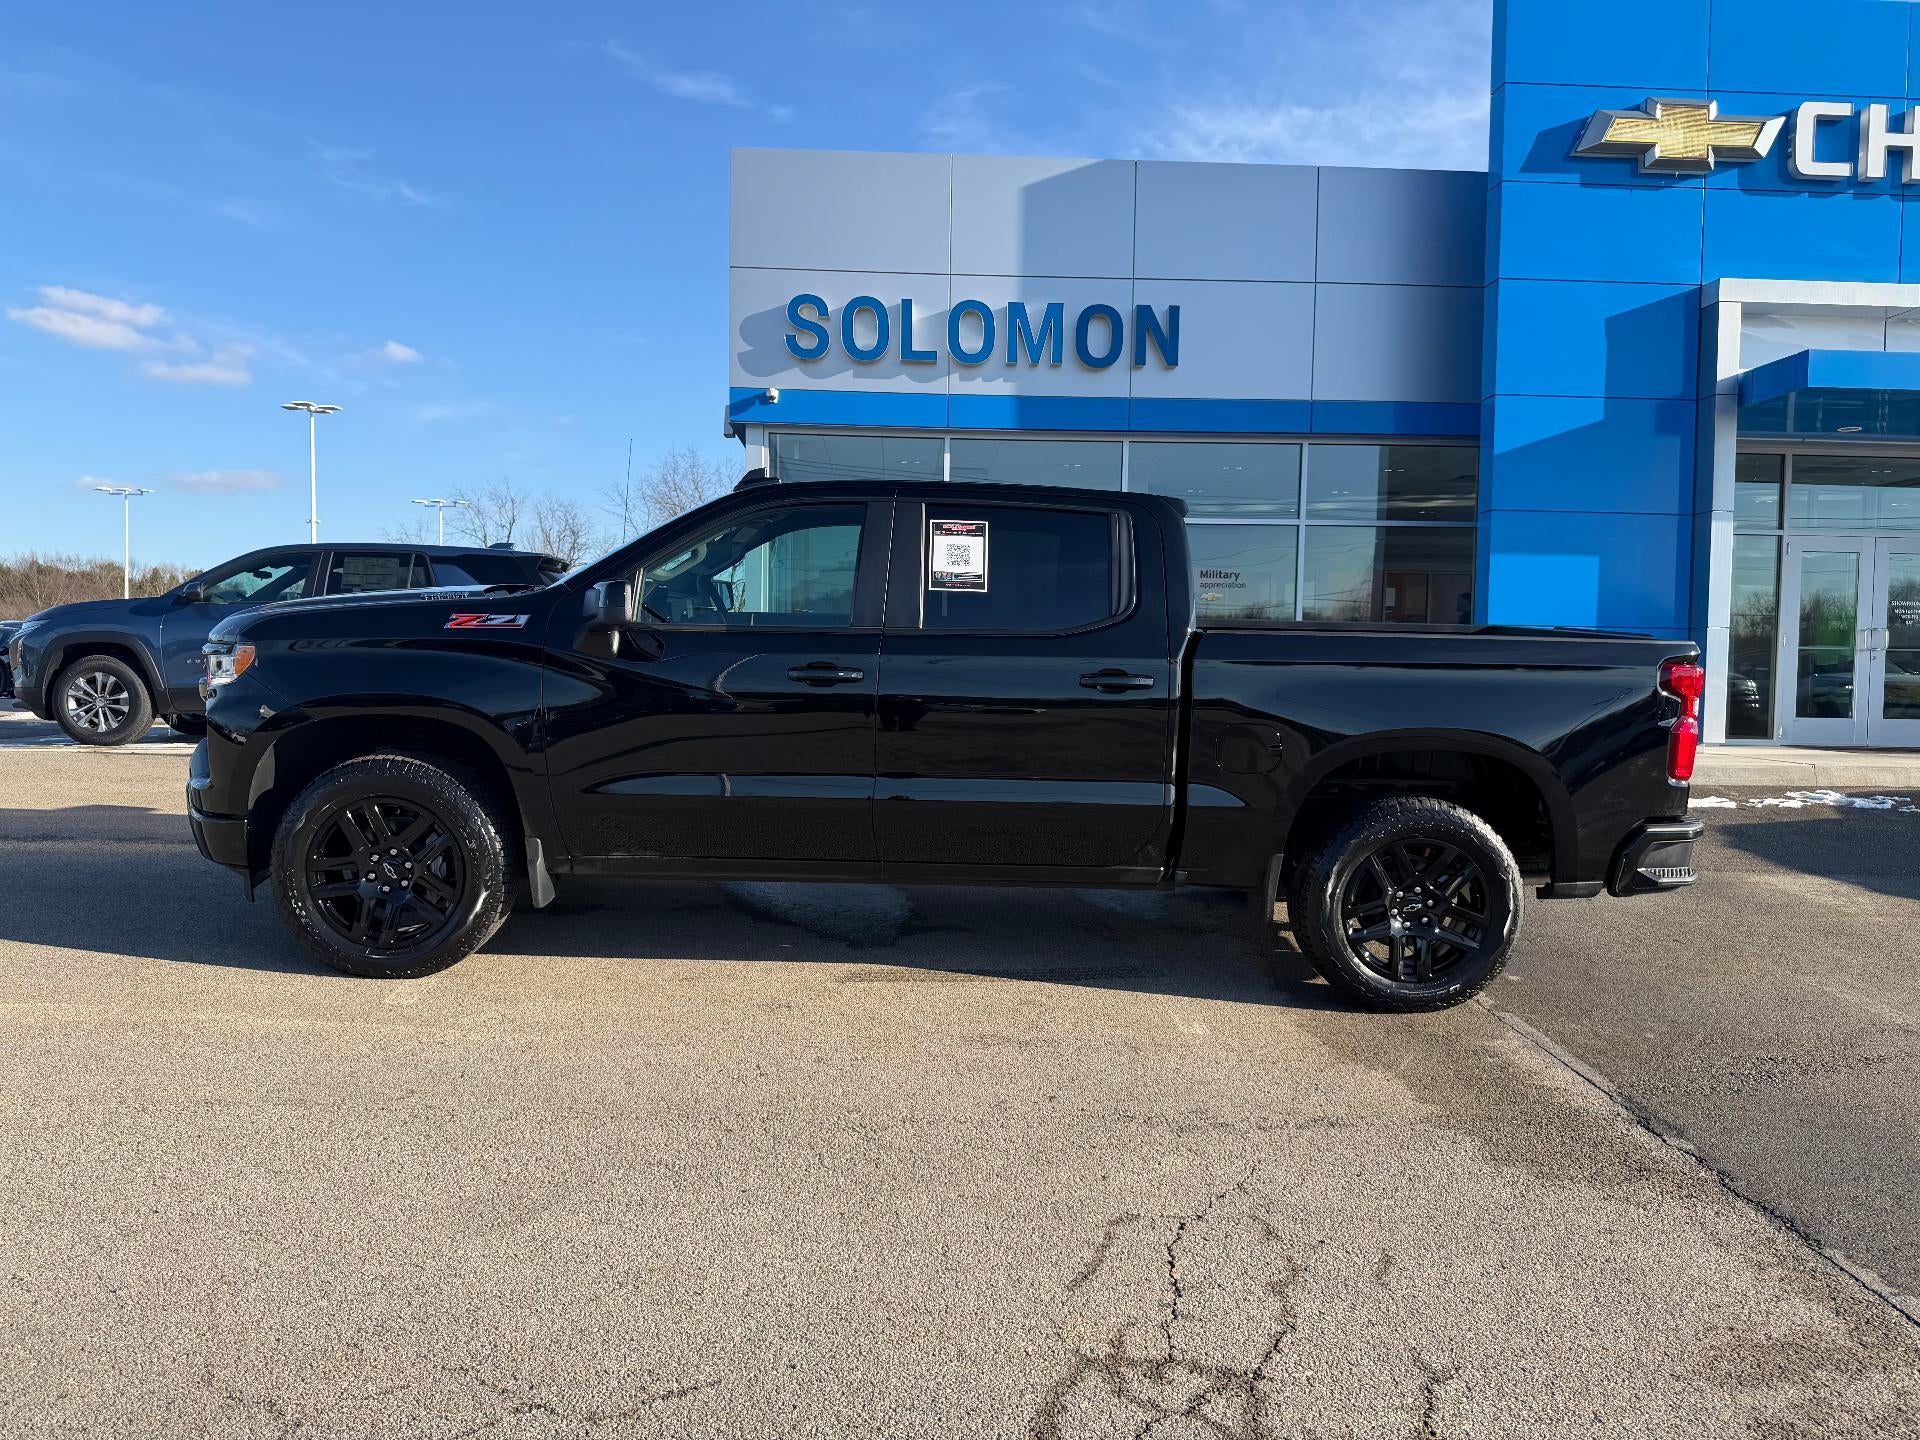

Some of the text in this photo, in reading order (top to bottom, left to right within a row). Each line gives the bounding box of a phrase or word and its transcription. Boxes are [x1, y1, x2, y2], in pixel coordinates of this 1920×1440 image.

[1789, 101, 1920, 183] CH
[784, 293, 1181, 369] SOLOMON
[1200, 569, 1240, 581] Military
[1200, 581, 1247, 589] appreciation
[444, 613, 532, 629] Z71
